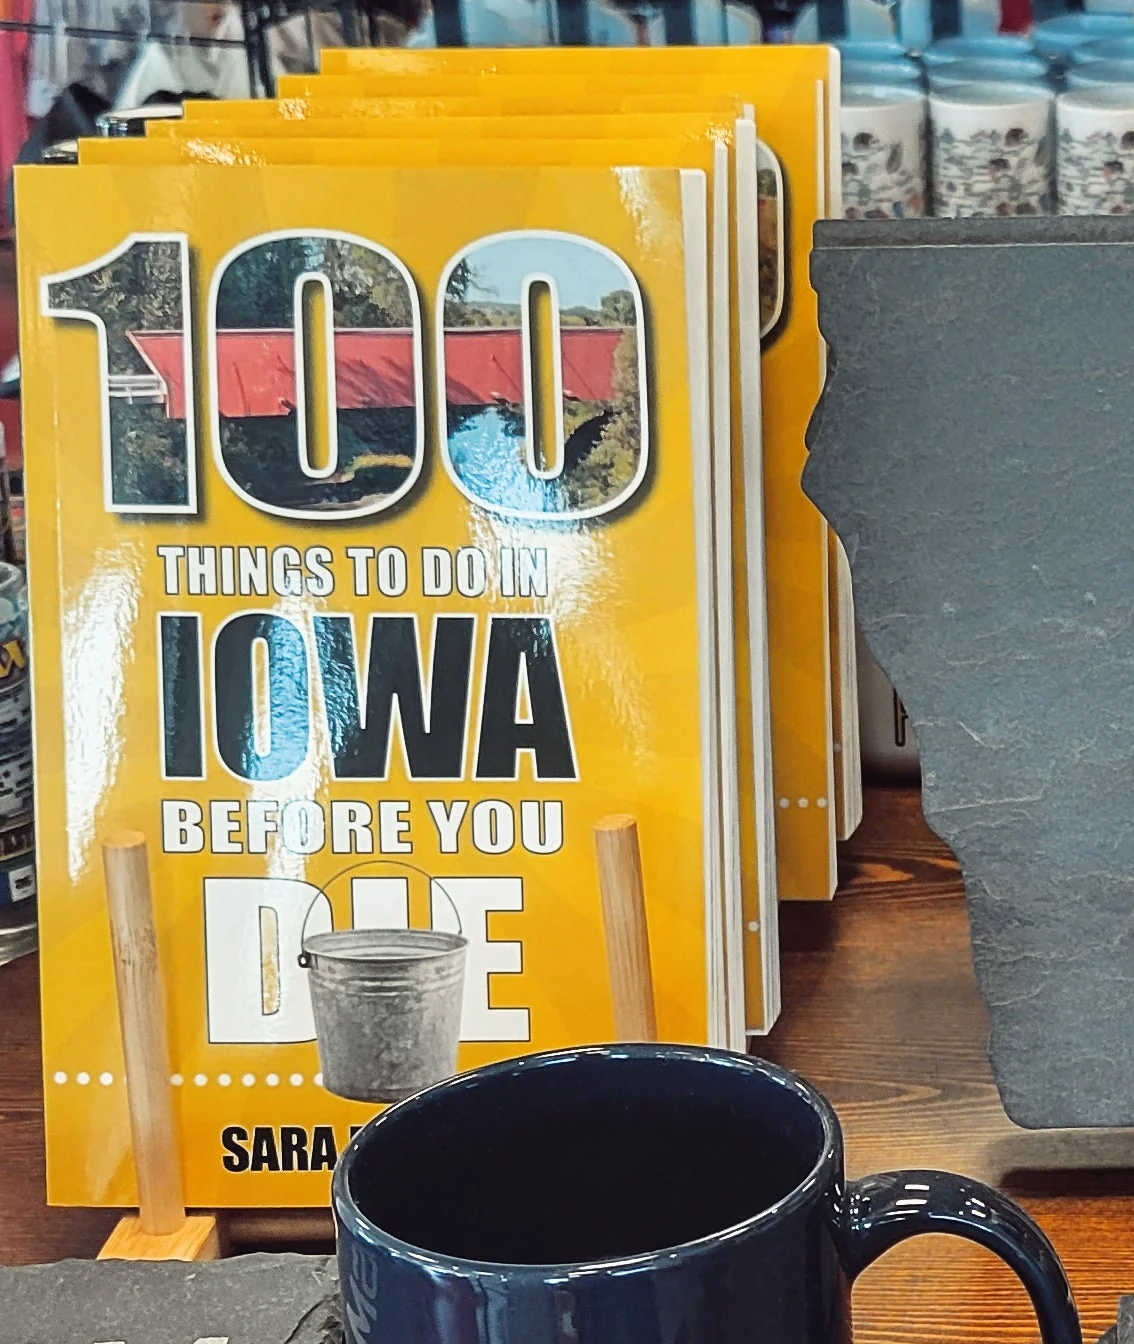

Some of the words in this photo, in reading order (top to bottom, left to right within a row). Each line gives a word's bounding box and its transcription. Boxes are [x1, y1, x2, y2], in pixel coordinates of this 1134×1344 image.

[40, 227, 650, 521] 100
[157, 545, 335, 598] THINGS
[345, 546, 408, 597] TO
[421, 546, 487, 598] DO
[499, 546, 549, 598] IN
[154, 609, 581, 782] IOWA
[160, 799, 414, 854] BEFORE
[427, 799, 564, 854] YOU
[221, 1125, 337, 1172] SARA
